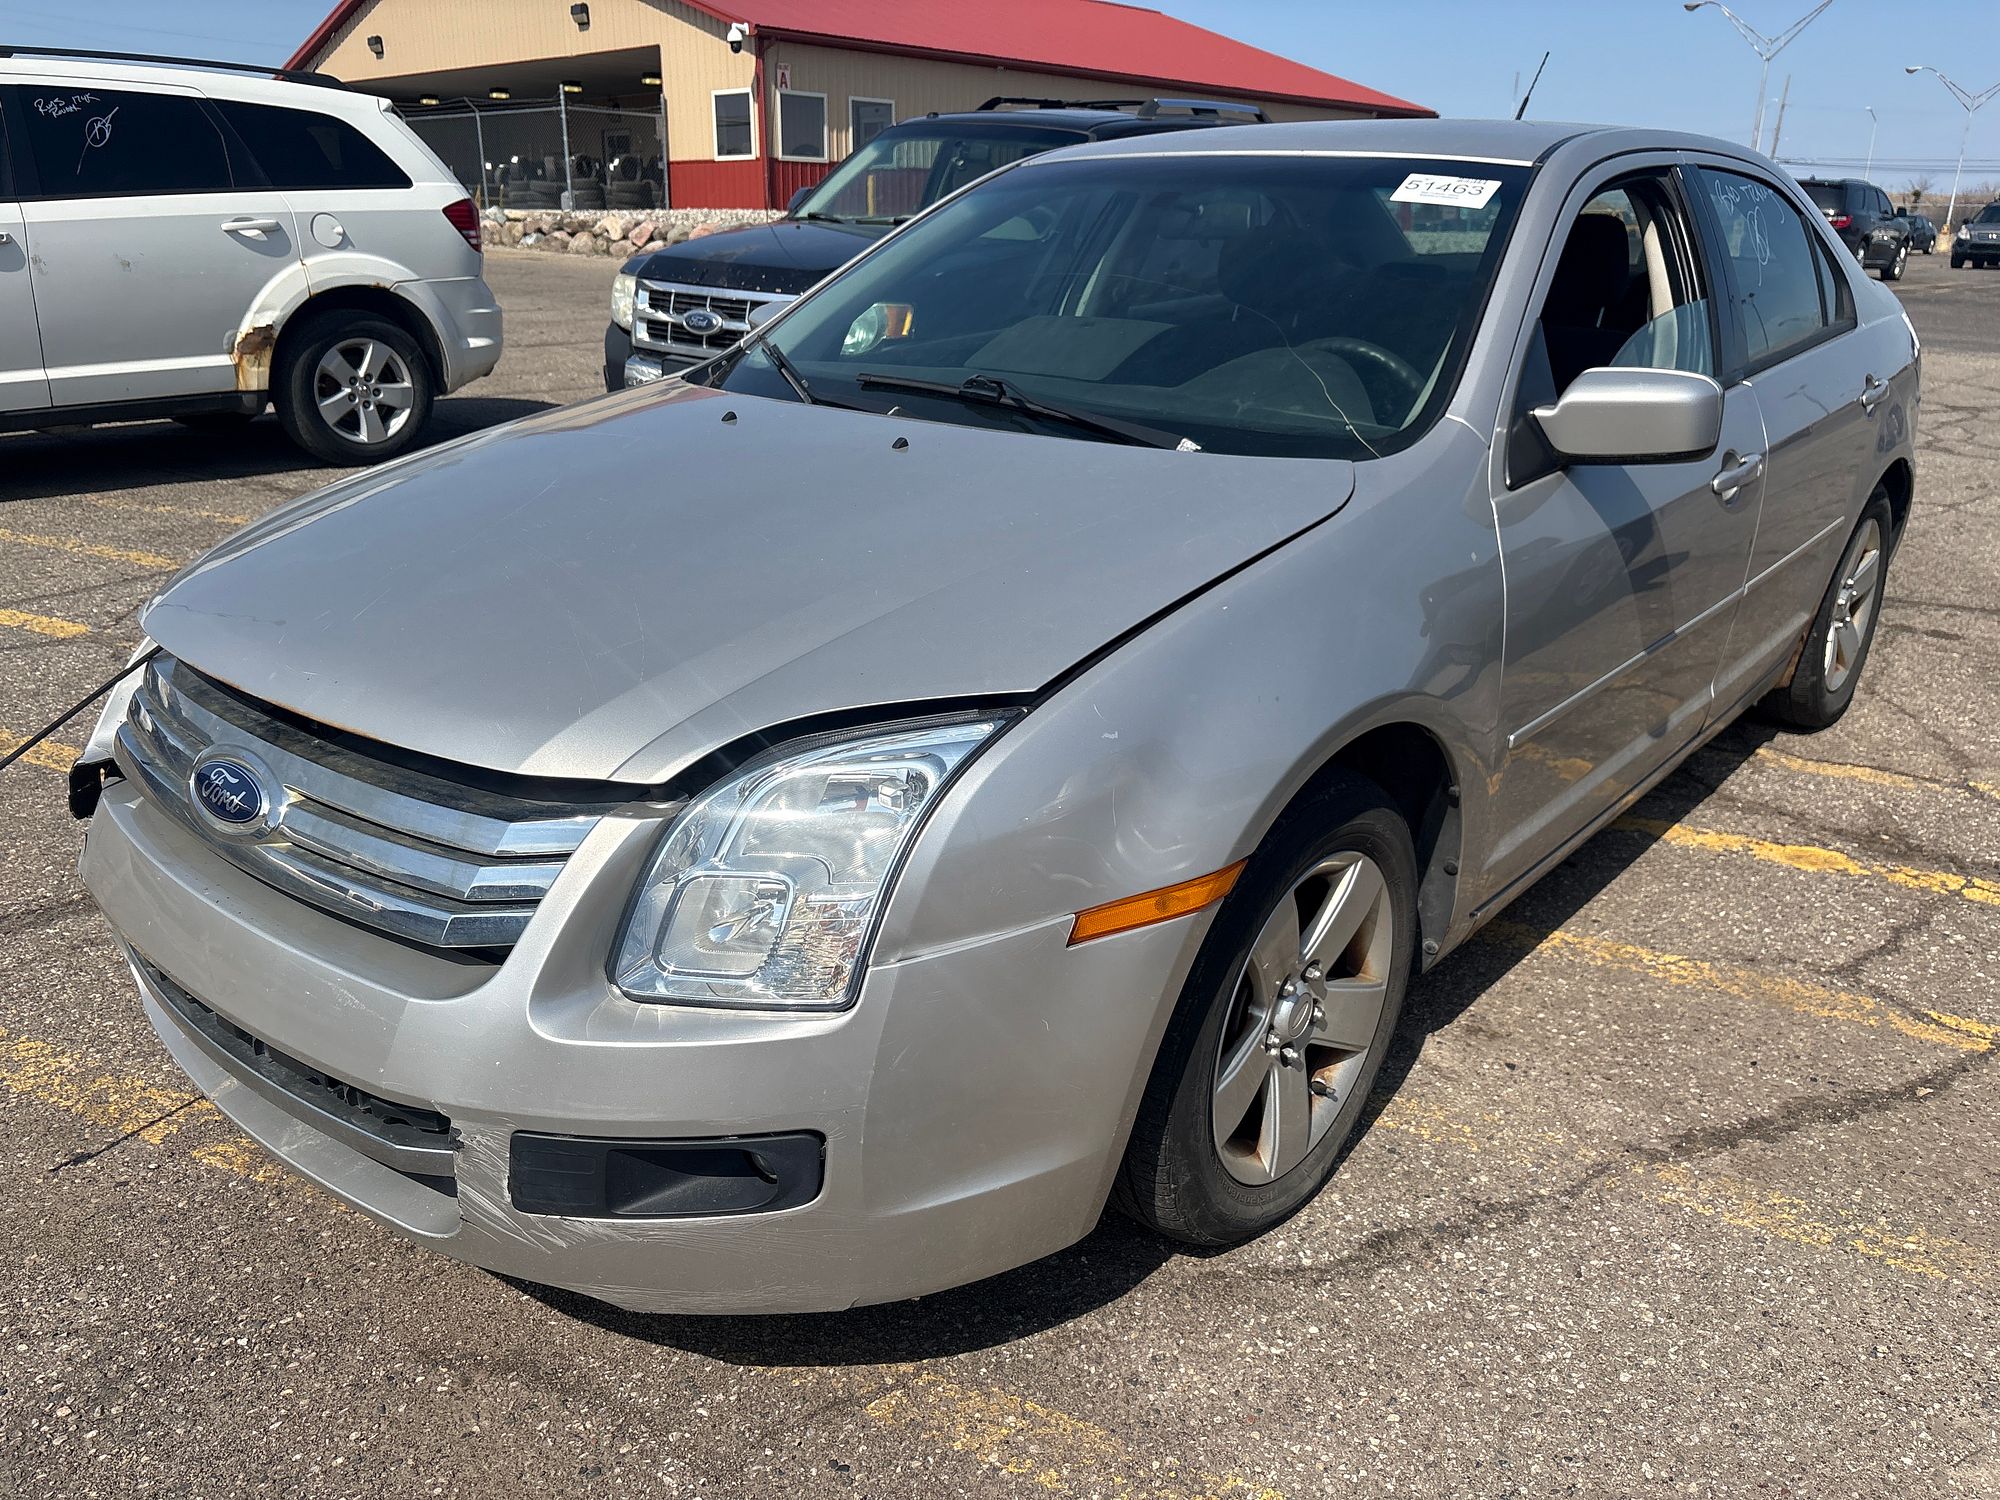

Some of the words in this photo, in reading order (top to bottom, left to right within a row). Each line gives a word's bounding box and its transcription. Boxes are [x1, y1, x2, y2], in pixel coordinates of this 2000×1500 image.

[780, 71, 789, 89] A
[1404, 179, 1485, 196] 51463
[202, 767, 254, 814] Ford
